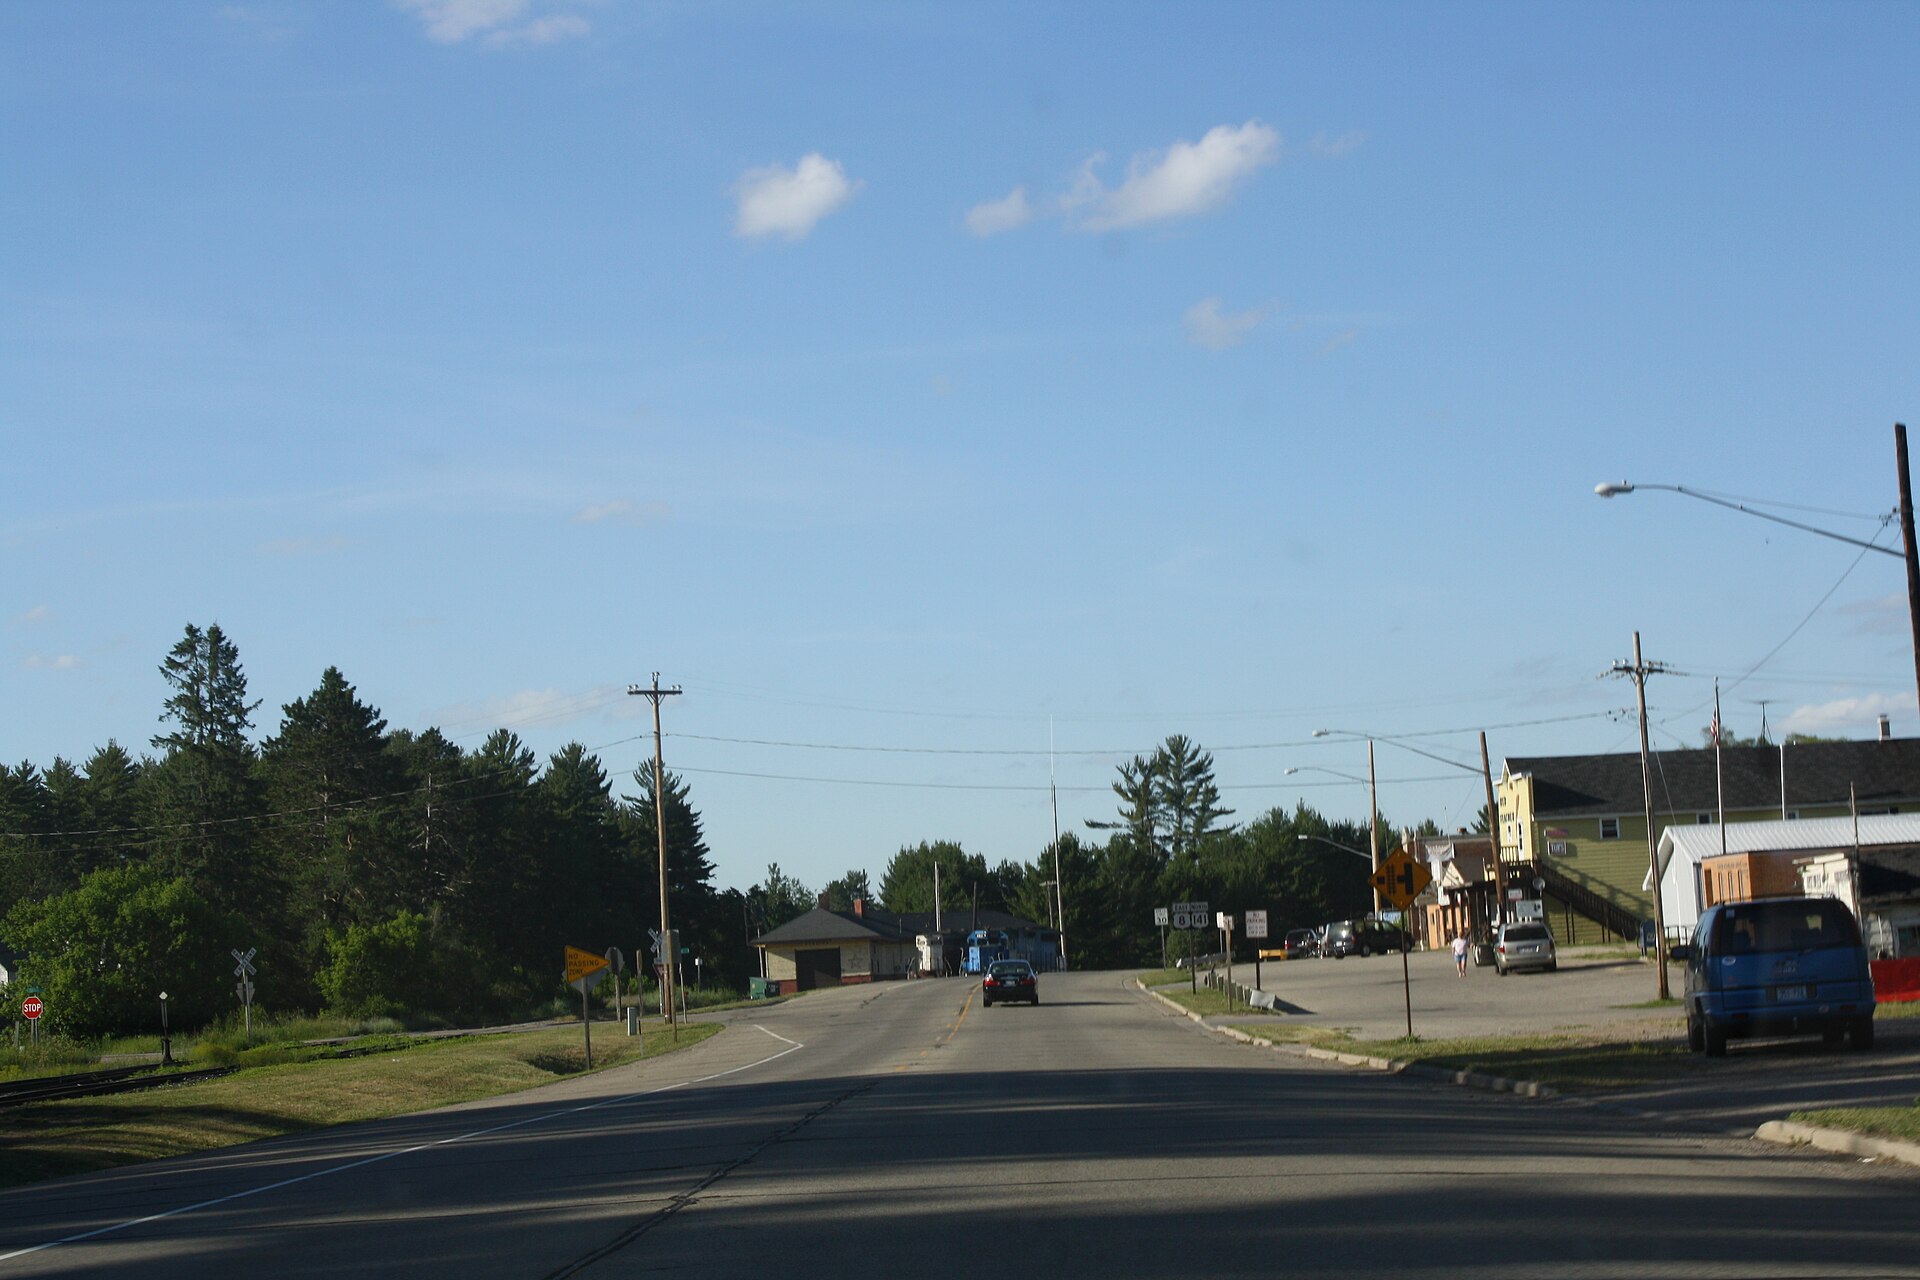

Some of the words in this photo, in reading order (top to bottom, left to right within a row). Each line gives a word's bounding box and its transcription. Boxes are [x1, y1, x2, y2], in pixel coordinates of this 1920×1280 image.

[1179, 915, 1185, 925] 8
[1193, 914, 1206, 925] 141
[568, 952, 578, 960] NO
[568, 959, 599, 967] PASSING
[24, 1003, 41, 1012] STOP
